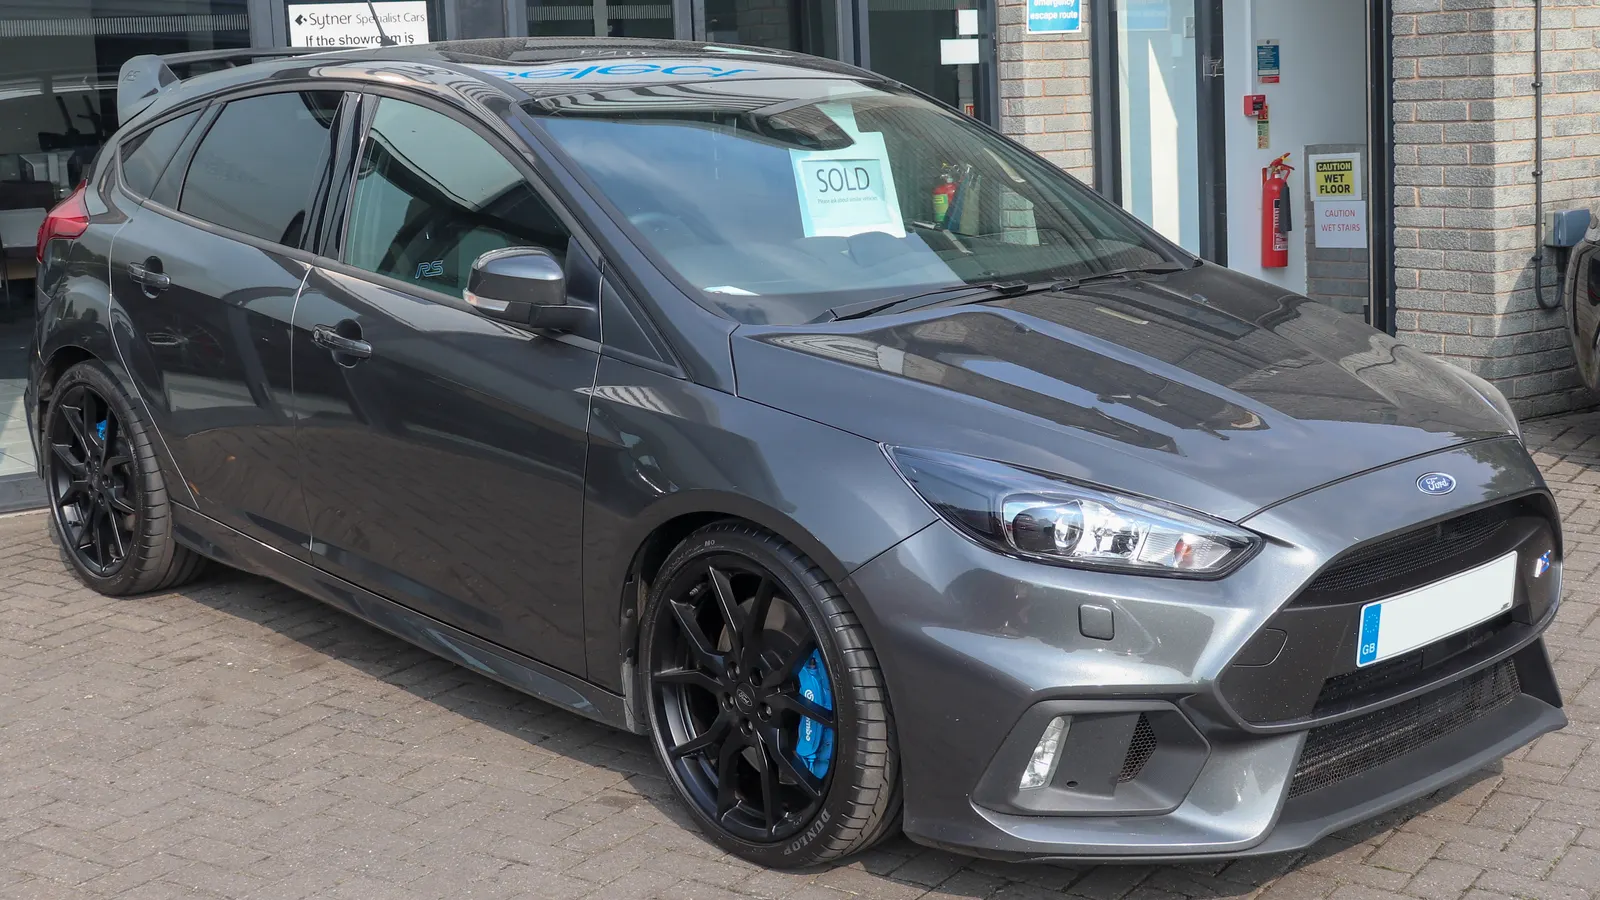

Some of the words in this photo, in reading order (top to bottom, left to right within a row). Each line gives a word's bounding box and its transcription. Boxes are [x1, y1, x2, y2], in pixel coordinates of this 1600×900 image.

[308, 12, 352, 29] Sytner
[356, 13, 401, 26] Speialist
[403, 12, 425, 22] Cars
[1030, 12, 1058, 20] escape
[1060, 11, 1078, 19] route
[305, 35, 313, 47] If
[316, 35, 335, 47] the
[404, 31, 415, 44] is
[1317, 162, 1351, 171] CAUTION
[816, 167, 870, 193] SOLD
[1324, 174, 1344, 183] WET
[1320, 184, 1350, 194] FLOOR
[1325, 209, 1356, 217] CAUTION
[415, 260, 444, 279] RS
[1425, 476, 1449, 491] Ford
[1362, 643, 1376, 655] GB
[783, 808, 831, 856] DUNLOP
